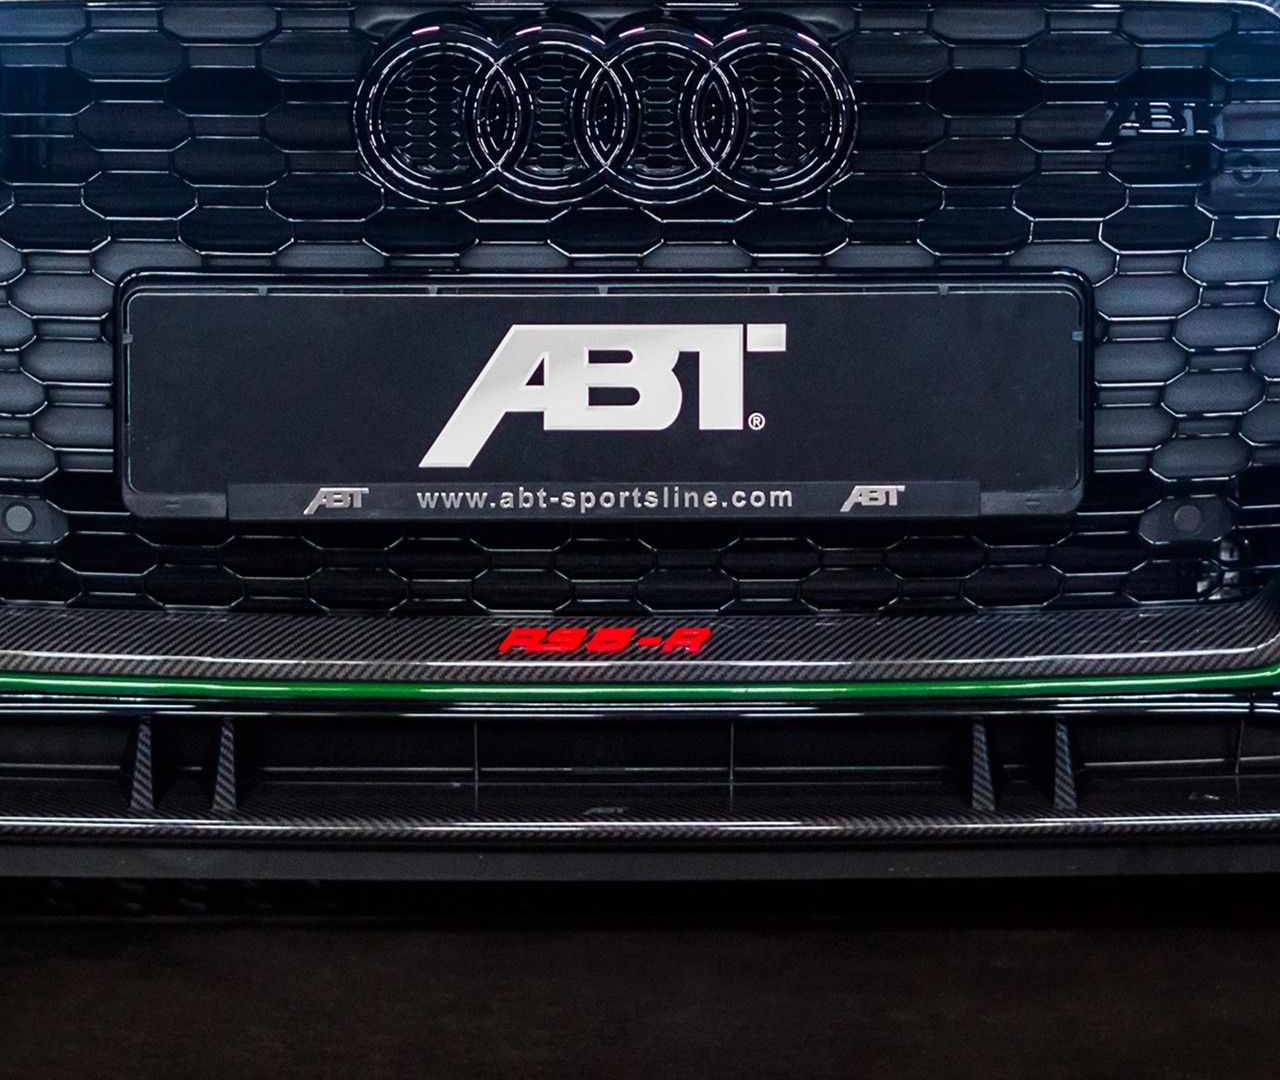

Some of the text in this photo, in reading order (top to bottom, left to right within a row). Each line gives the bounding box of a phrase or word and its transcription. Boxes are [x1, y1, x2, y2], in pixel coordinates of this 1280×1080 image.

[1095, 100, 1225, 146] ABT
[418, 323, 787, 468] ABT
[303, 487, 370, 515] ABT
[416, 486, 793, 514] www.abt-sportsline.com
[839, 485, 906, 512] ABT
